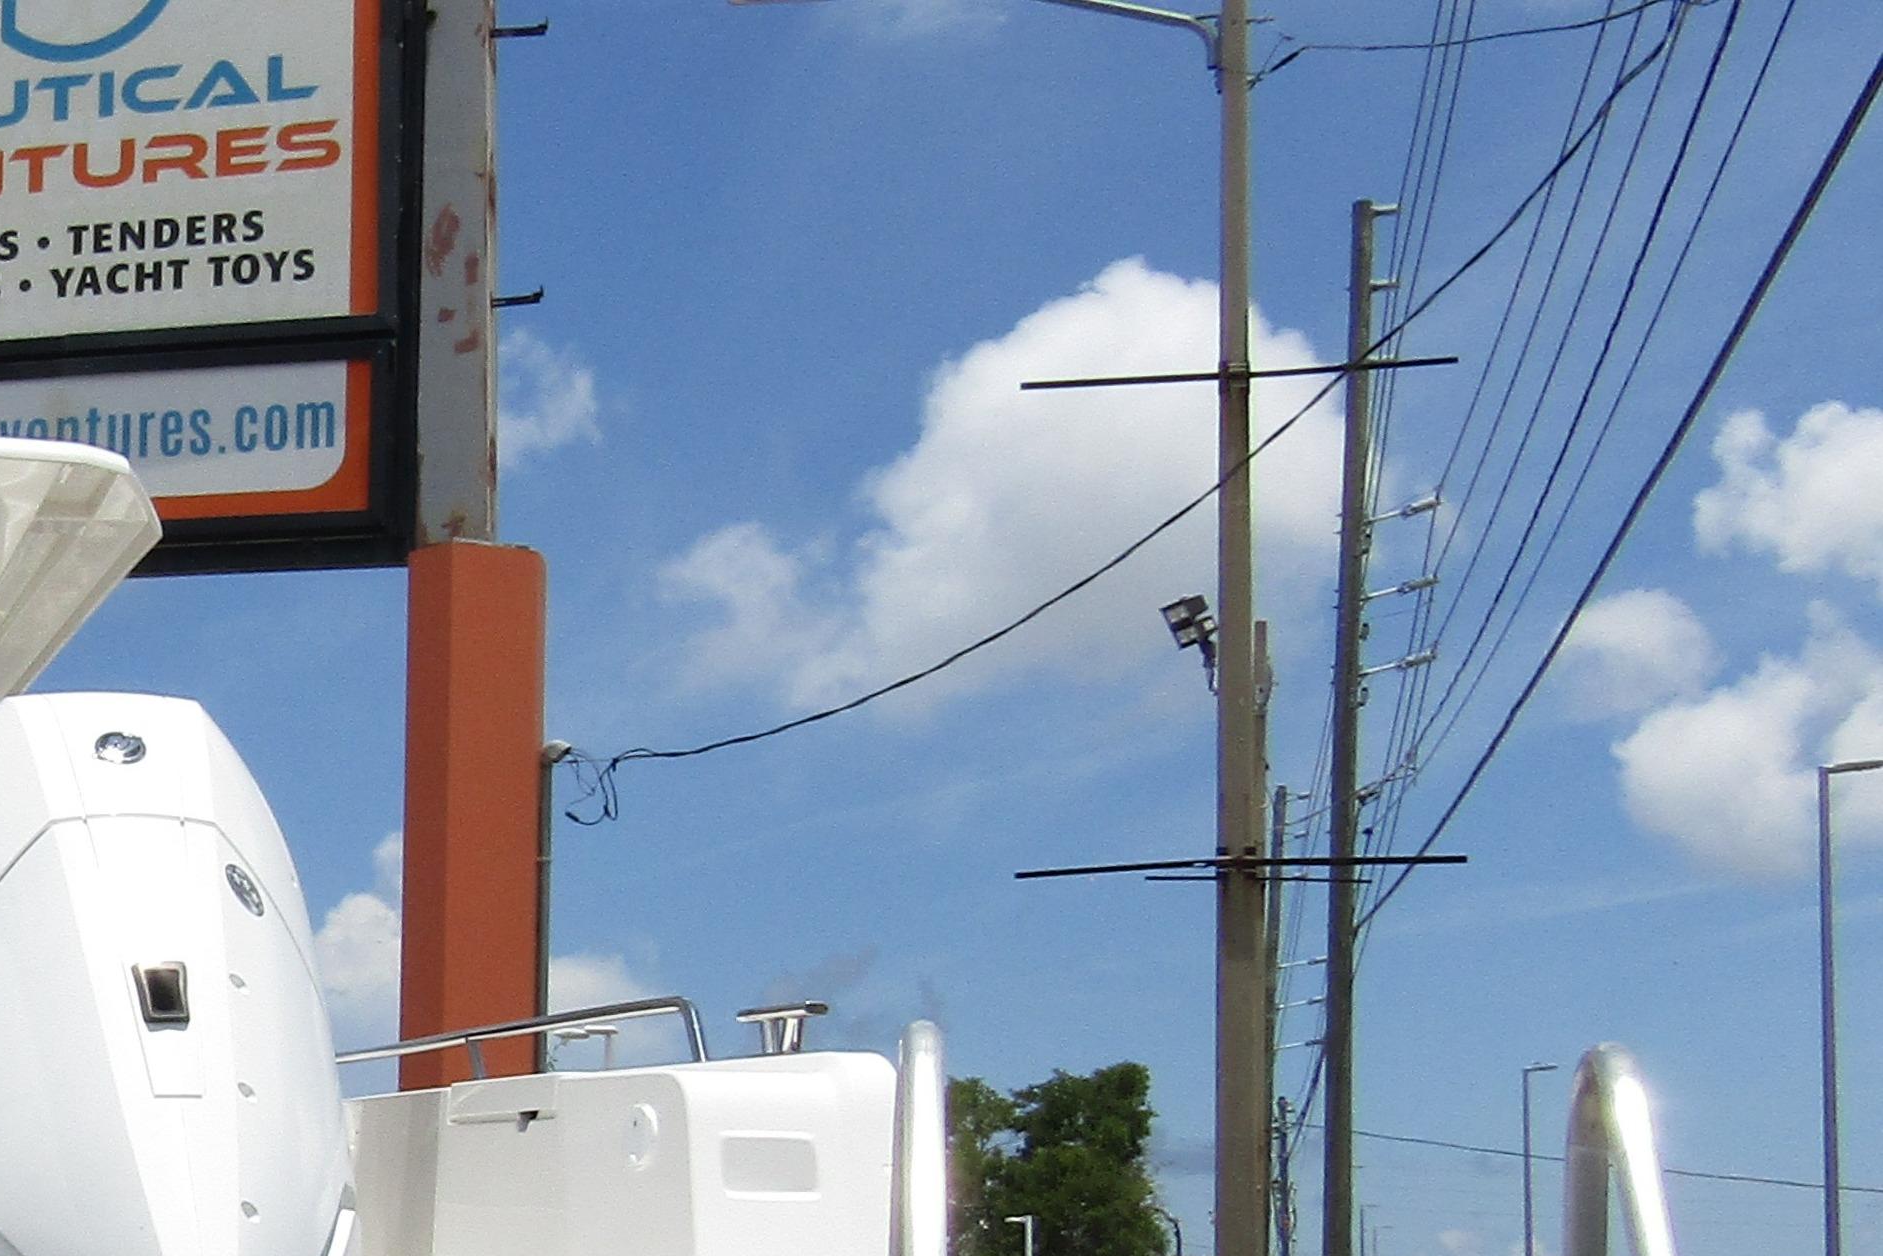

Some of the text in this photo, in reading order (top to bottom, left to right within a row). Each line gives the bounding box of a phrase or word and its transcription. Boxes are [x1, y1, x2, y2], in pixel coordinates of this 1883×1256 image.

[67, 210, 265, 256] TENDERS
[49, 258, 190, 299] YACHT
[207, 248, 316, 288] TOYS
